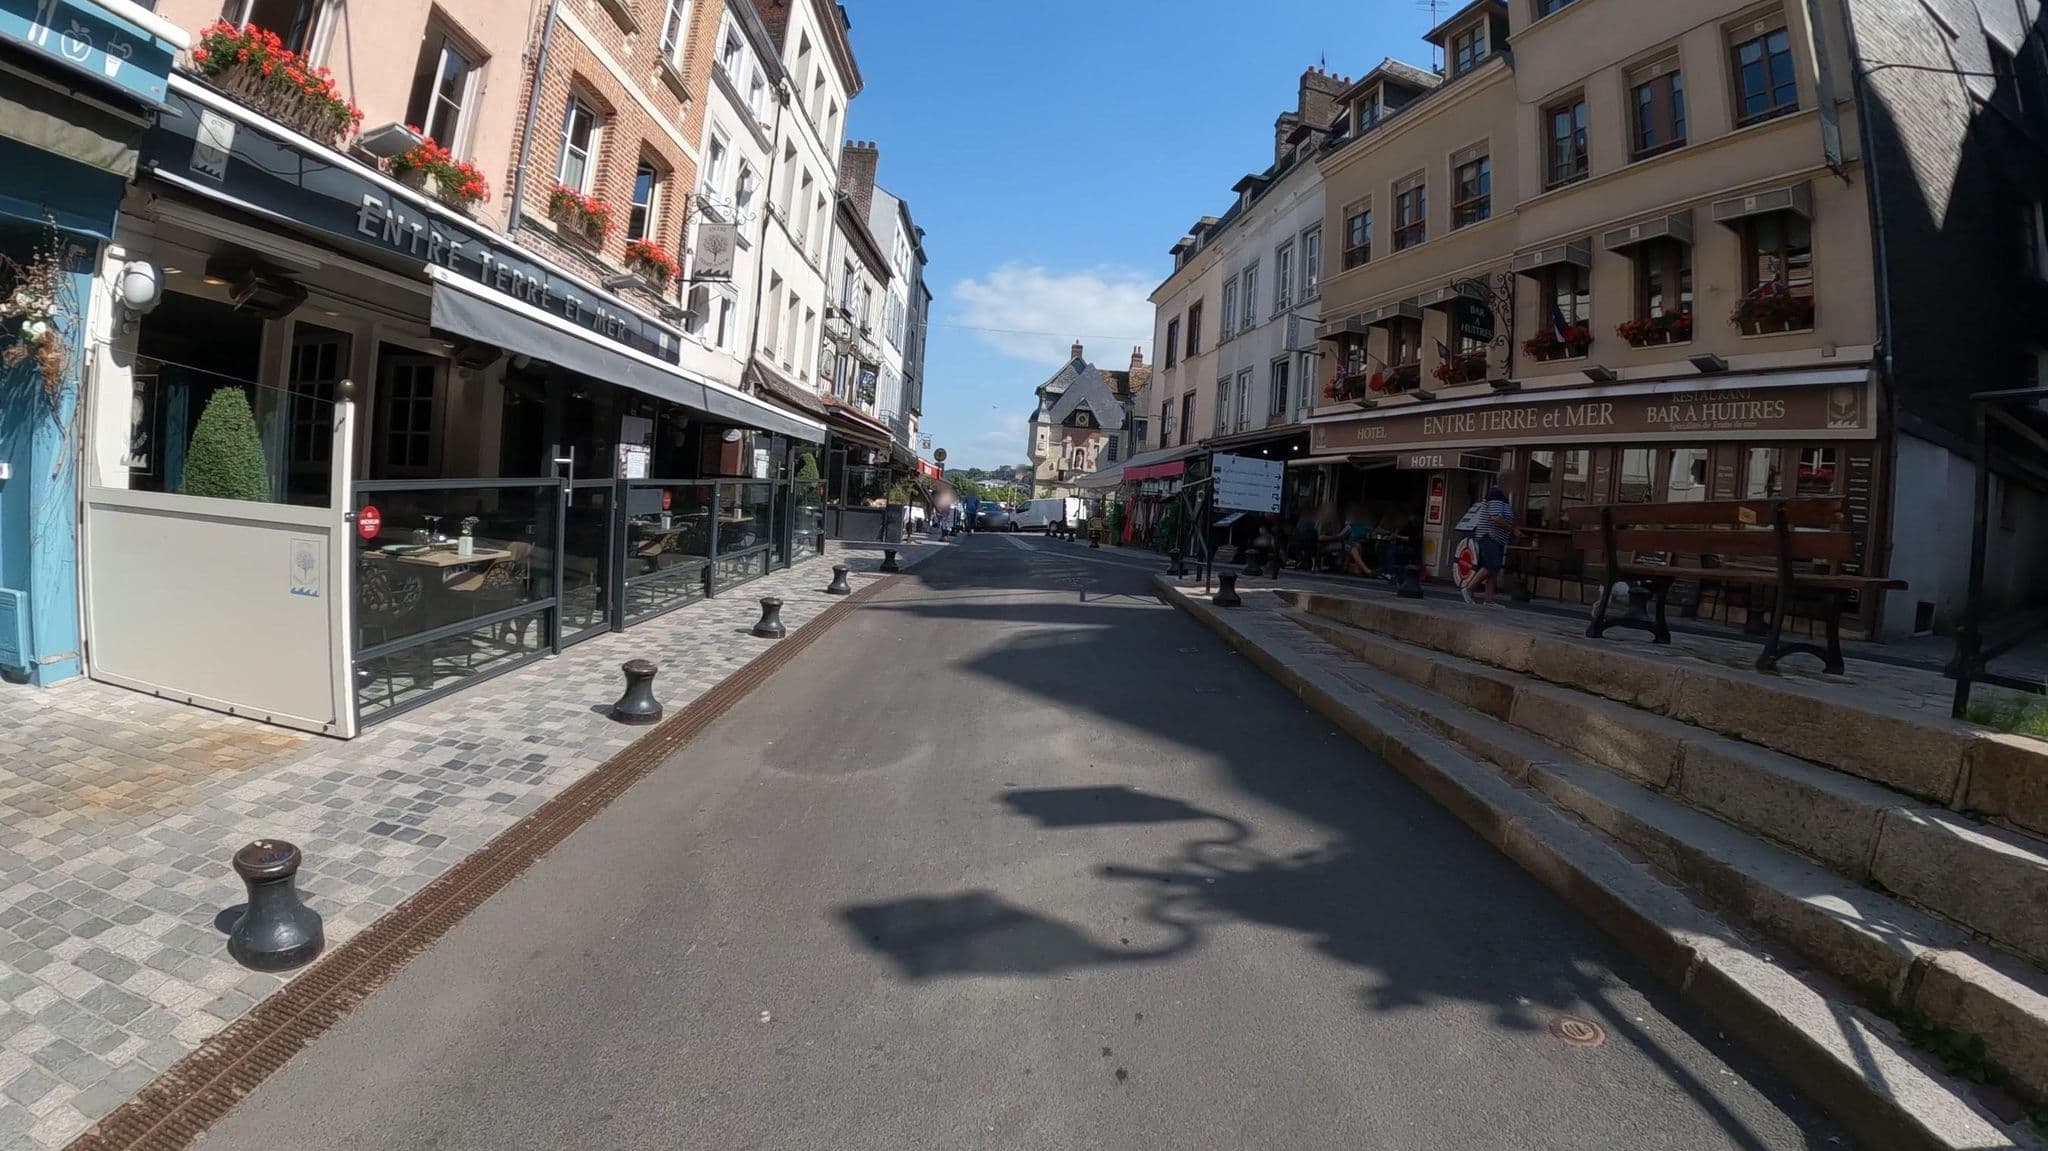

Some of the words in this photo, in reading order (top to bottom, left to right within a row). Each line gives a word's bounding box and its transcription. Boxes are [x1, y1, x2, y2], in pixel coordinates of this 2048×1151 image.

[357, 193, 463, 272] ENTRE
[479, 250, 551, 308] TERRE
[593, 306, 626, 341] MER
[1423, 412, 1476, 435] ENTRE
[1479, 408, 1538, 431] TERRE
[1543, 408, 1560, 428] et
[1564, 402, 1615, 427] MER
[1647, 405, 1680, 423] BAR
[1685, 404, 1698, 422] A
[1702, 400, 1785, 421] HUITRES
[1357, 426, 1387, 440] HOTEL
[1411, 455, 1444, 467] HOTEL
